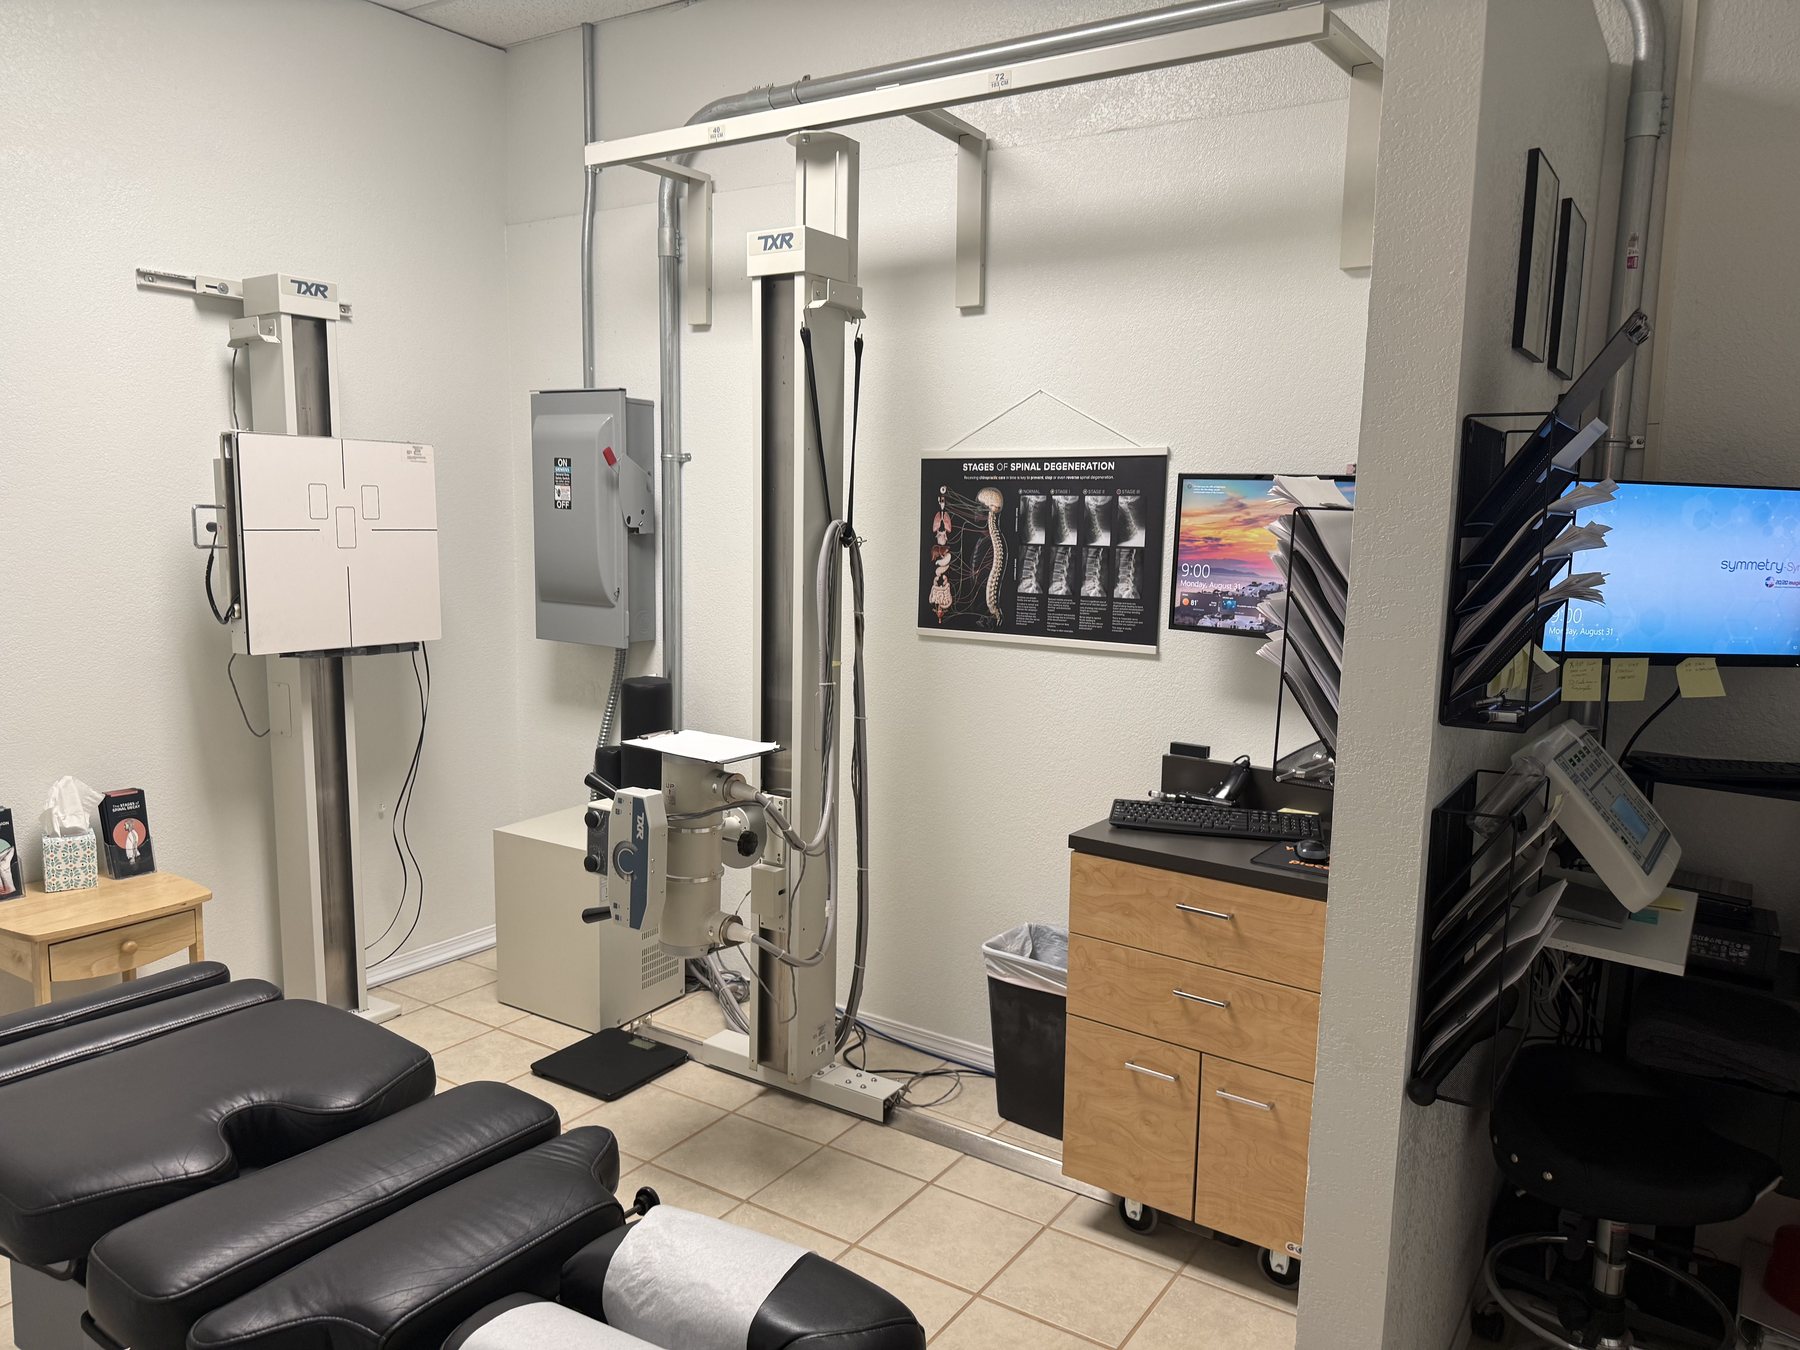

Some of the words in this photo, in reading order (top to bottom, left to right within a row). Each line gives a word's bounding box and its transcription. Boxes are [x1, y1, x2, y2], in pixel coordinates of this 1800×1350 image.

[995, 72, 1005, 81] 72
[757, 232, 794, 251] TXR
[290, 279, 329, 299] TXR
[557, 458, 568, 467] ON
[962, 462, 995, 472] STAGES
[996, 462, 1009, 471] OF
[1010, 462, 1041, 472] SPINAL
[1043, 461, 1115, 471] DEGENERATION
[556, 500, 570, 509] OFF
[1181, 563, 1210, 579] 9:00
[1720, 558, 1784, 574] symmetry
[1180, 580, 1208, 589] Monday,
[1208, 581, 1232, 590] August
[1580, 627, 1604, 637] August
[636, 812, 645, 841] TXR
